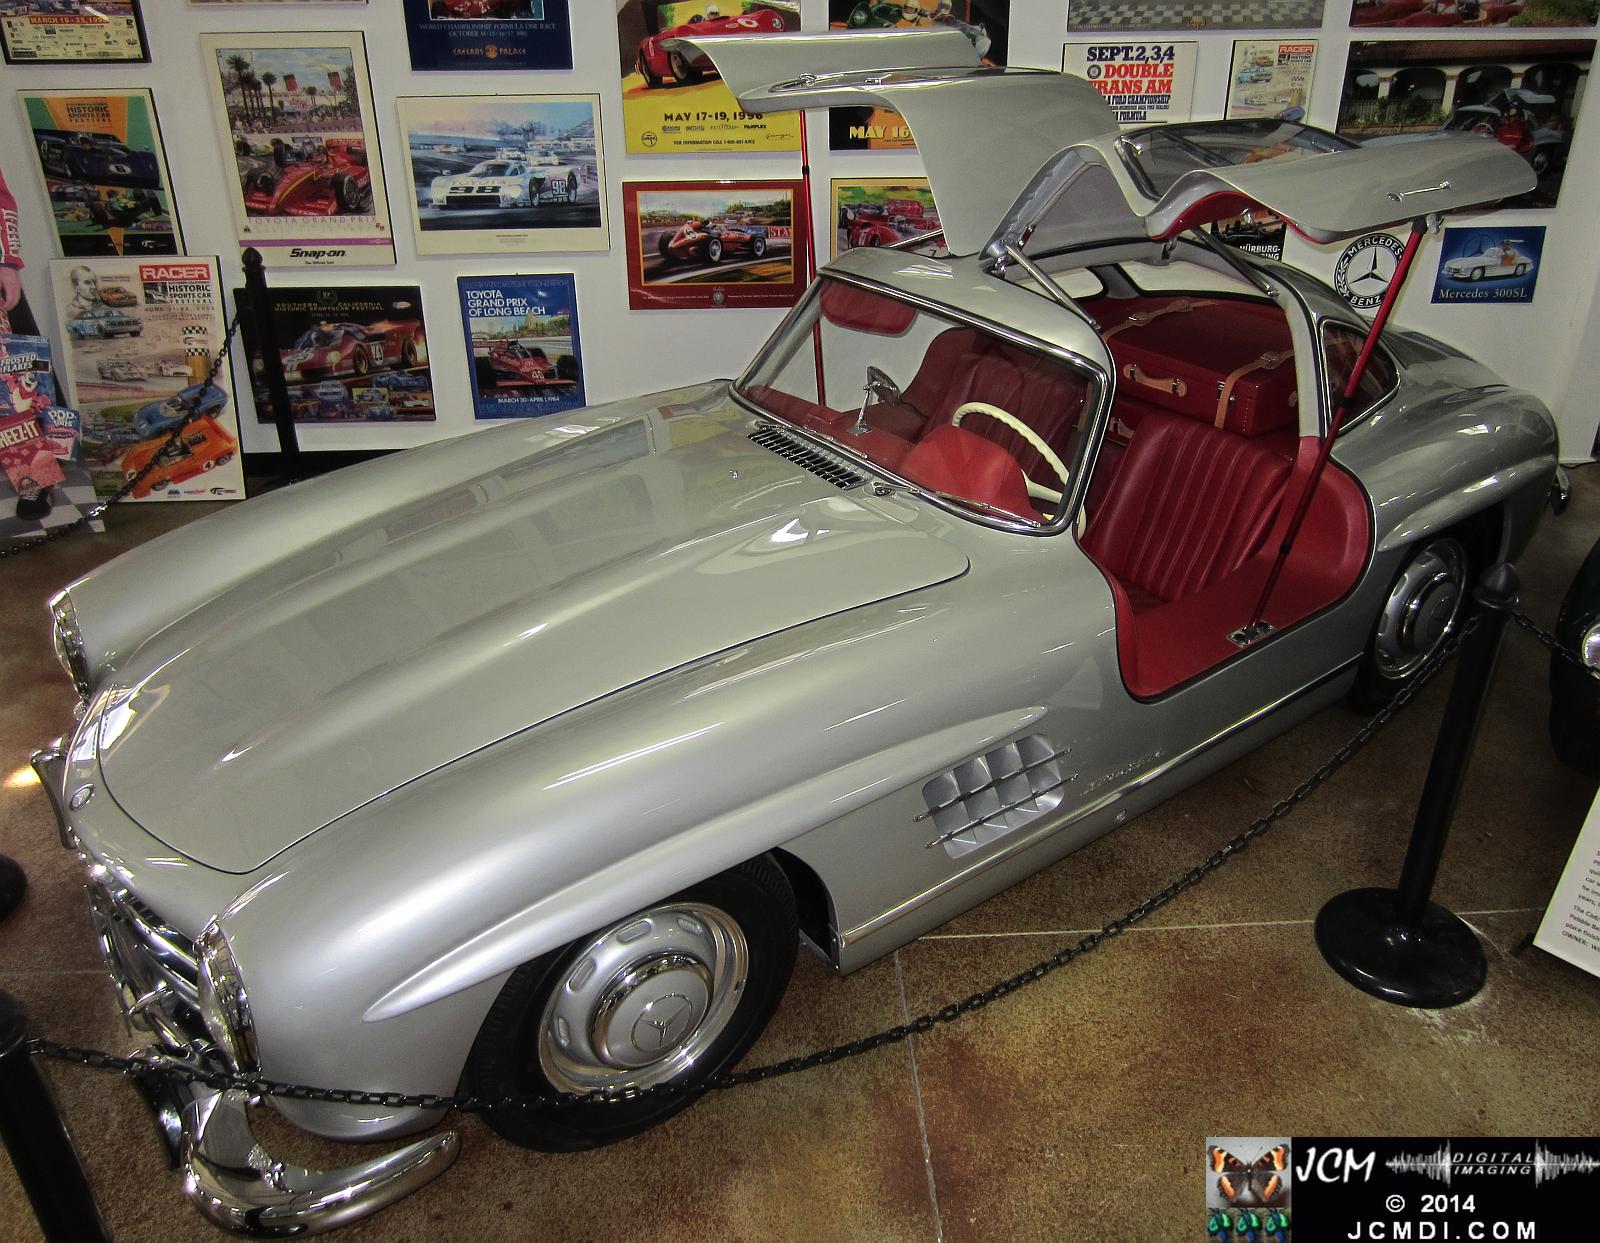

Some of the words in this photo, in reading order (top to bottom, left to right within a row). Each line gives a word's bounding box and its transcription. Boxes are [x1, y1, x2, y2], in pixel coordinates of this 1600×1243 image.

[31, 16, 57, 24] MARCH
[499, 47, 526, 55] PALACE
[1104, 63, 1175, 78] DOUBLE
[1145, 79, 1173, 93] AM
[1127, 94, 1171, 104] CHAMPIONSHIP
[664, 112, 691, 122] MAY
[696, 111, 729, 122] 17-19,
[849, 125, 886, 139] MAY
[248, 217, 297, 225] TOYOTA
[303, 216, 346, 224] GRAND
[1348, 236, 1403, 257] MERCEDES
[290, 248, 346, 259] Snap-on
[142, 266, 209, 280] RACER
[168, 284, 211, 292] HISTORIC
[1439, 288, 1489, 299] Mercedes
[1493, 287, 1528, 298] 300SL
[466, 290, 503, 299] TOYOTA
[468, 298, 505, 308] GRAND
[506, 298, 528, 306] PRIX
[1351, 296, 1381, 306] BENZ
[469, 309, 482, 317] OF
[484, 307, 512, 316] LONG
[513, 306, 546, 316] BEACH
[0, 354, 37, 367] FROSTED
[2, 362, 33, 373] FLAKES
[0, 420, 39, 448] HEEZ-IT
[1573, 904, 1585, 913] The
[1569, 913, 1590, 927] Pebble
[1565, 922, 1582, 934] place
[1562, 930, 1588, 946] OWNER:
